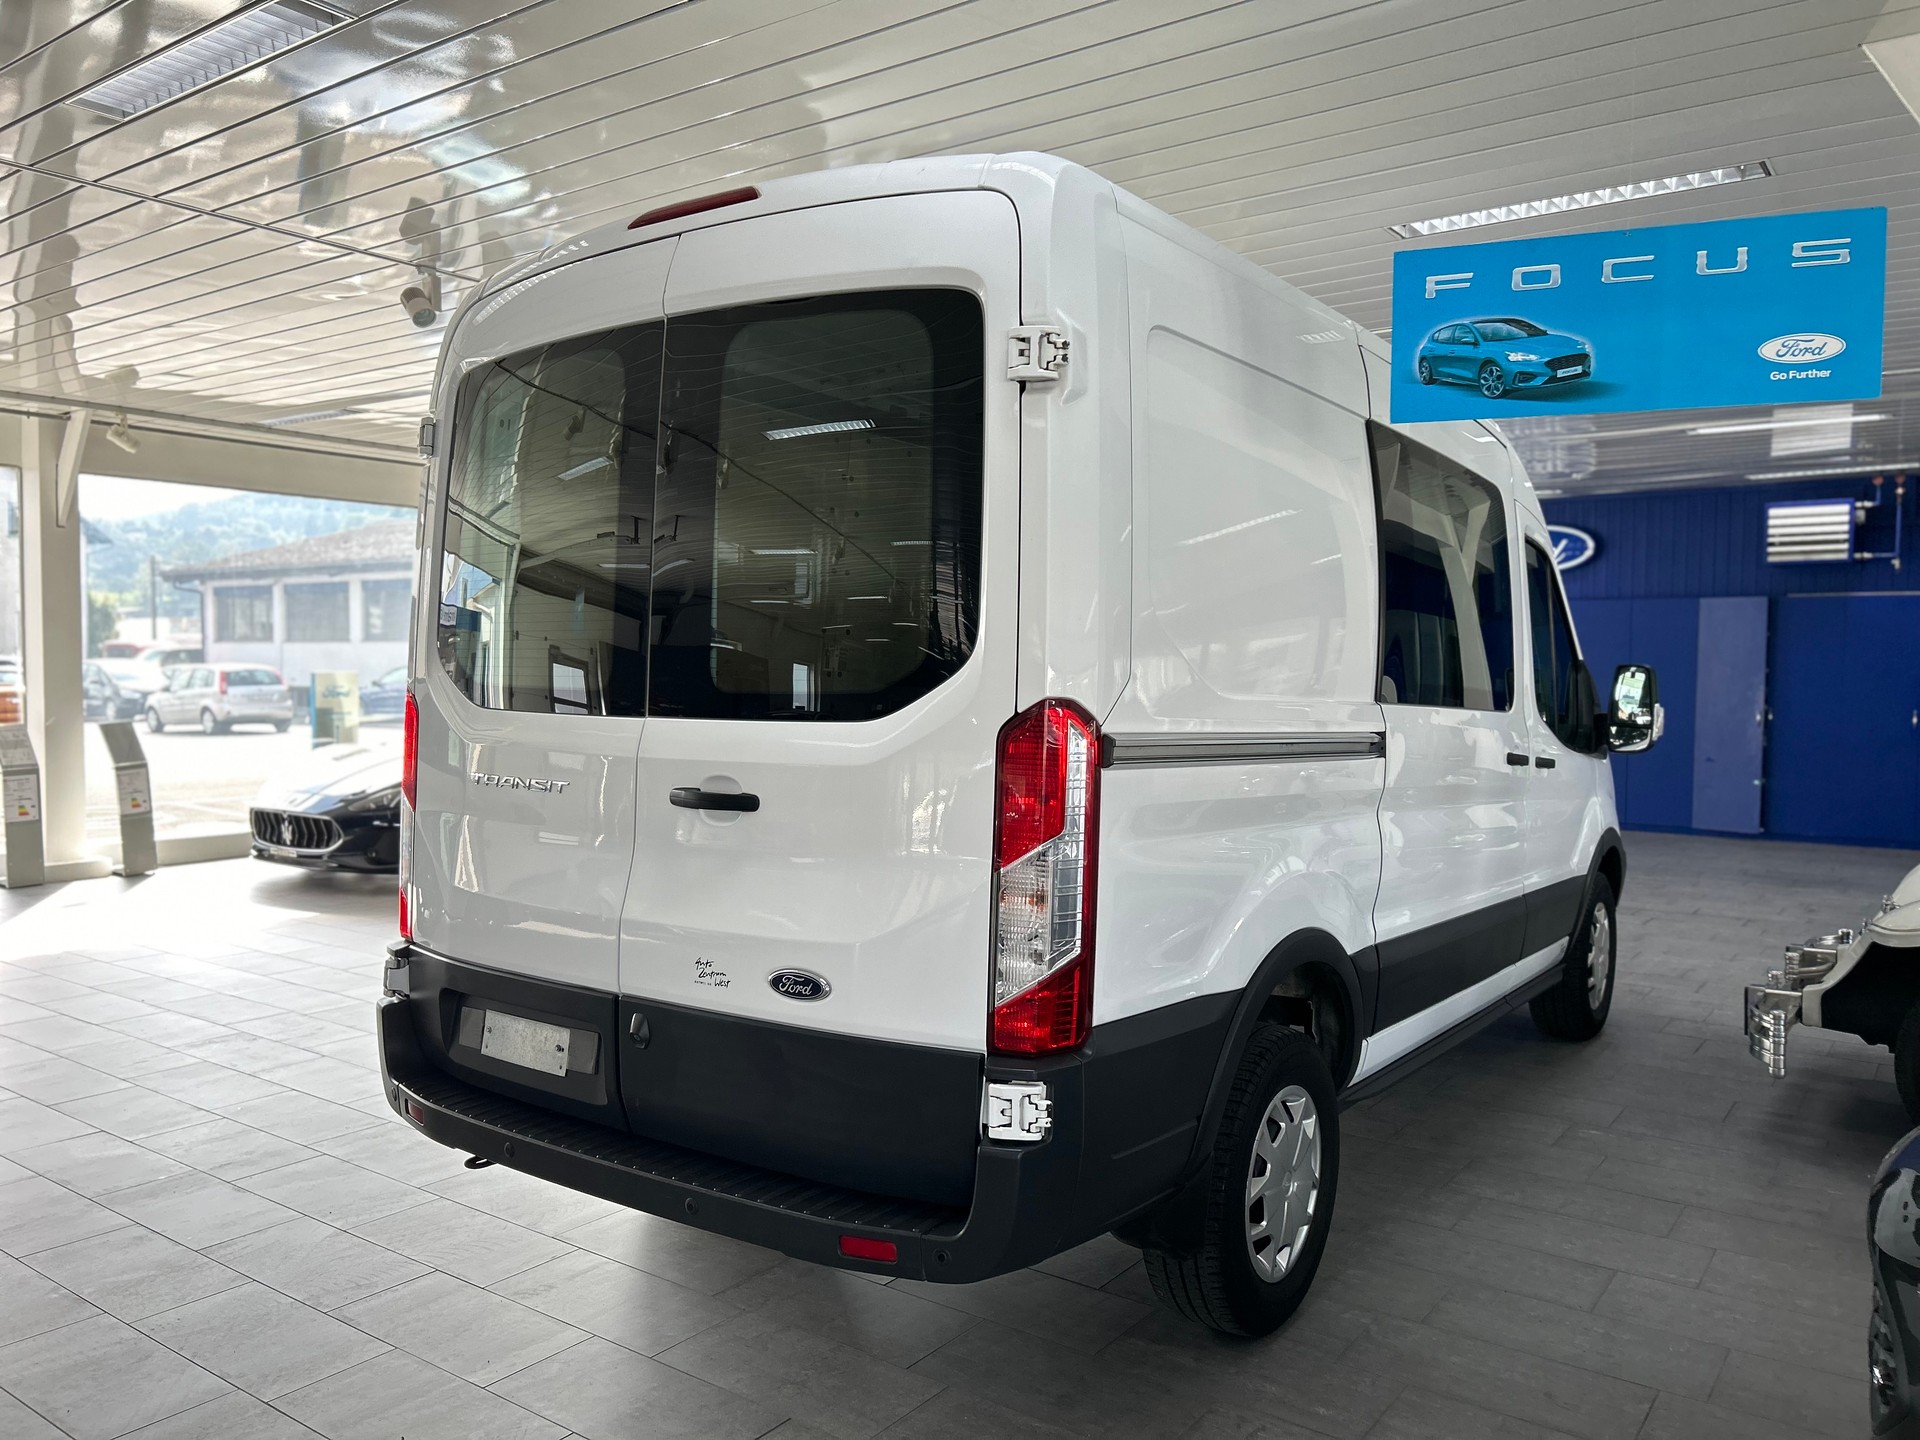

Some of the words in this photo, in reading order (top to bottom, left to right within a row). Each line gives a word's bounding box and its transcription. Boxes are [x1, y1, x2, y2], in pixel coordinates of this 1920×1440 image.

[1425, 238, 1851, 298] FOCUS
[1776, 338, 1828, 358] Ford
[1770, 371, 1787, 380] Go
[1789, 369, 1831, 380] Further
[470, 772, 570, 794] TRANSIT
[695, 957, 714, 970] Auto
[714, 977, 731, 988] West
[778, 975, 813, 995] Ford
